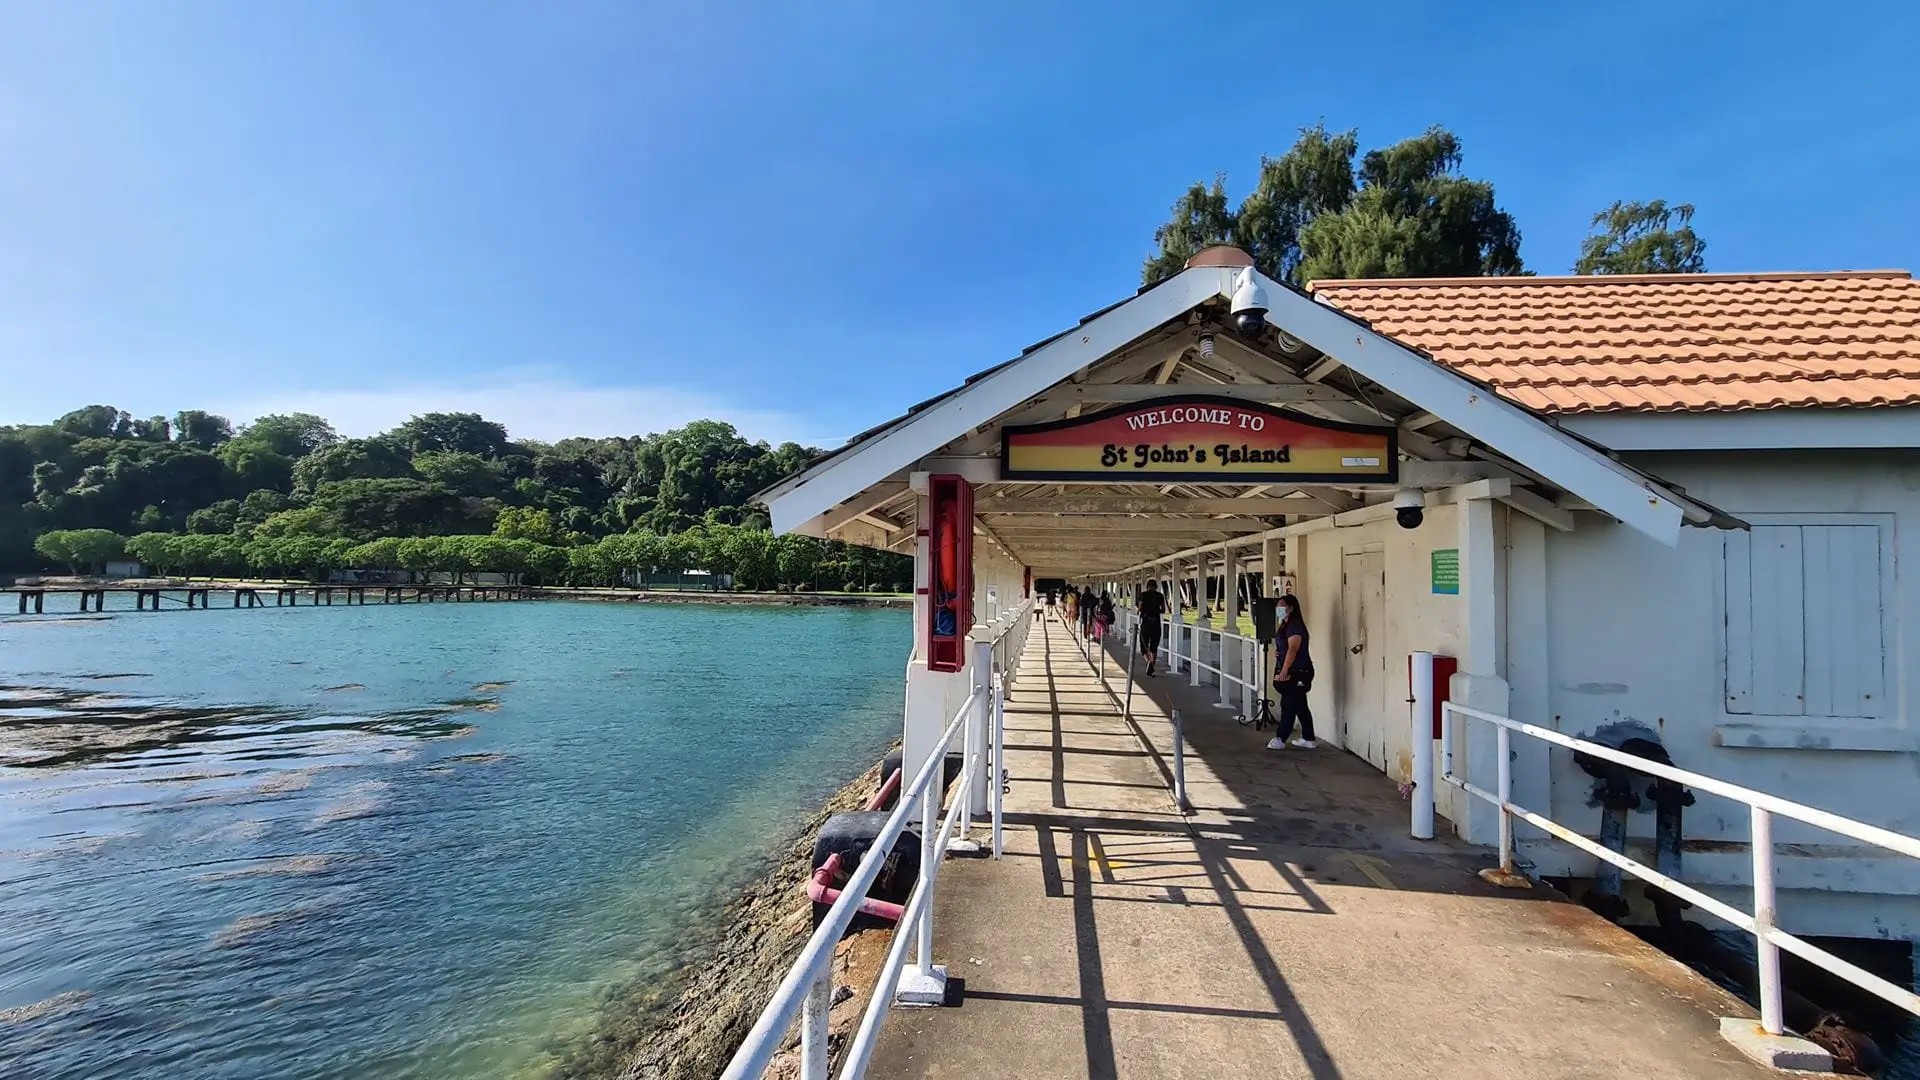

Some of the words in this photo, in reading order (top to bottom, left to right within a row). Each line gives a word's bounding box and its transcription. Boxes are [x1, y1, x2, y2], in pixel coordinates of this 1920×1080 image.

[1126, 407, 1232, 431] WELCOME
[1238, 413, 1265, 431] TO
[1101, 444, 1128, 467] St
[1134, 444, 1206, 468] John's
[1214, 444, 1291, 466] Island
